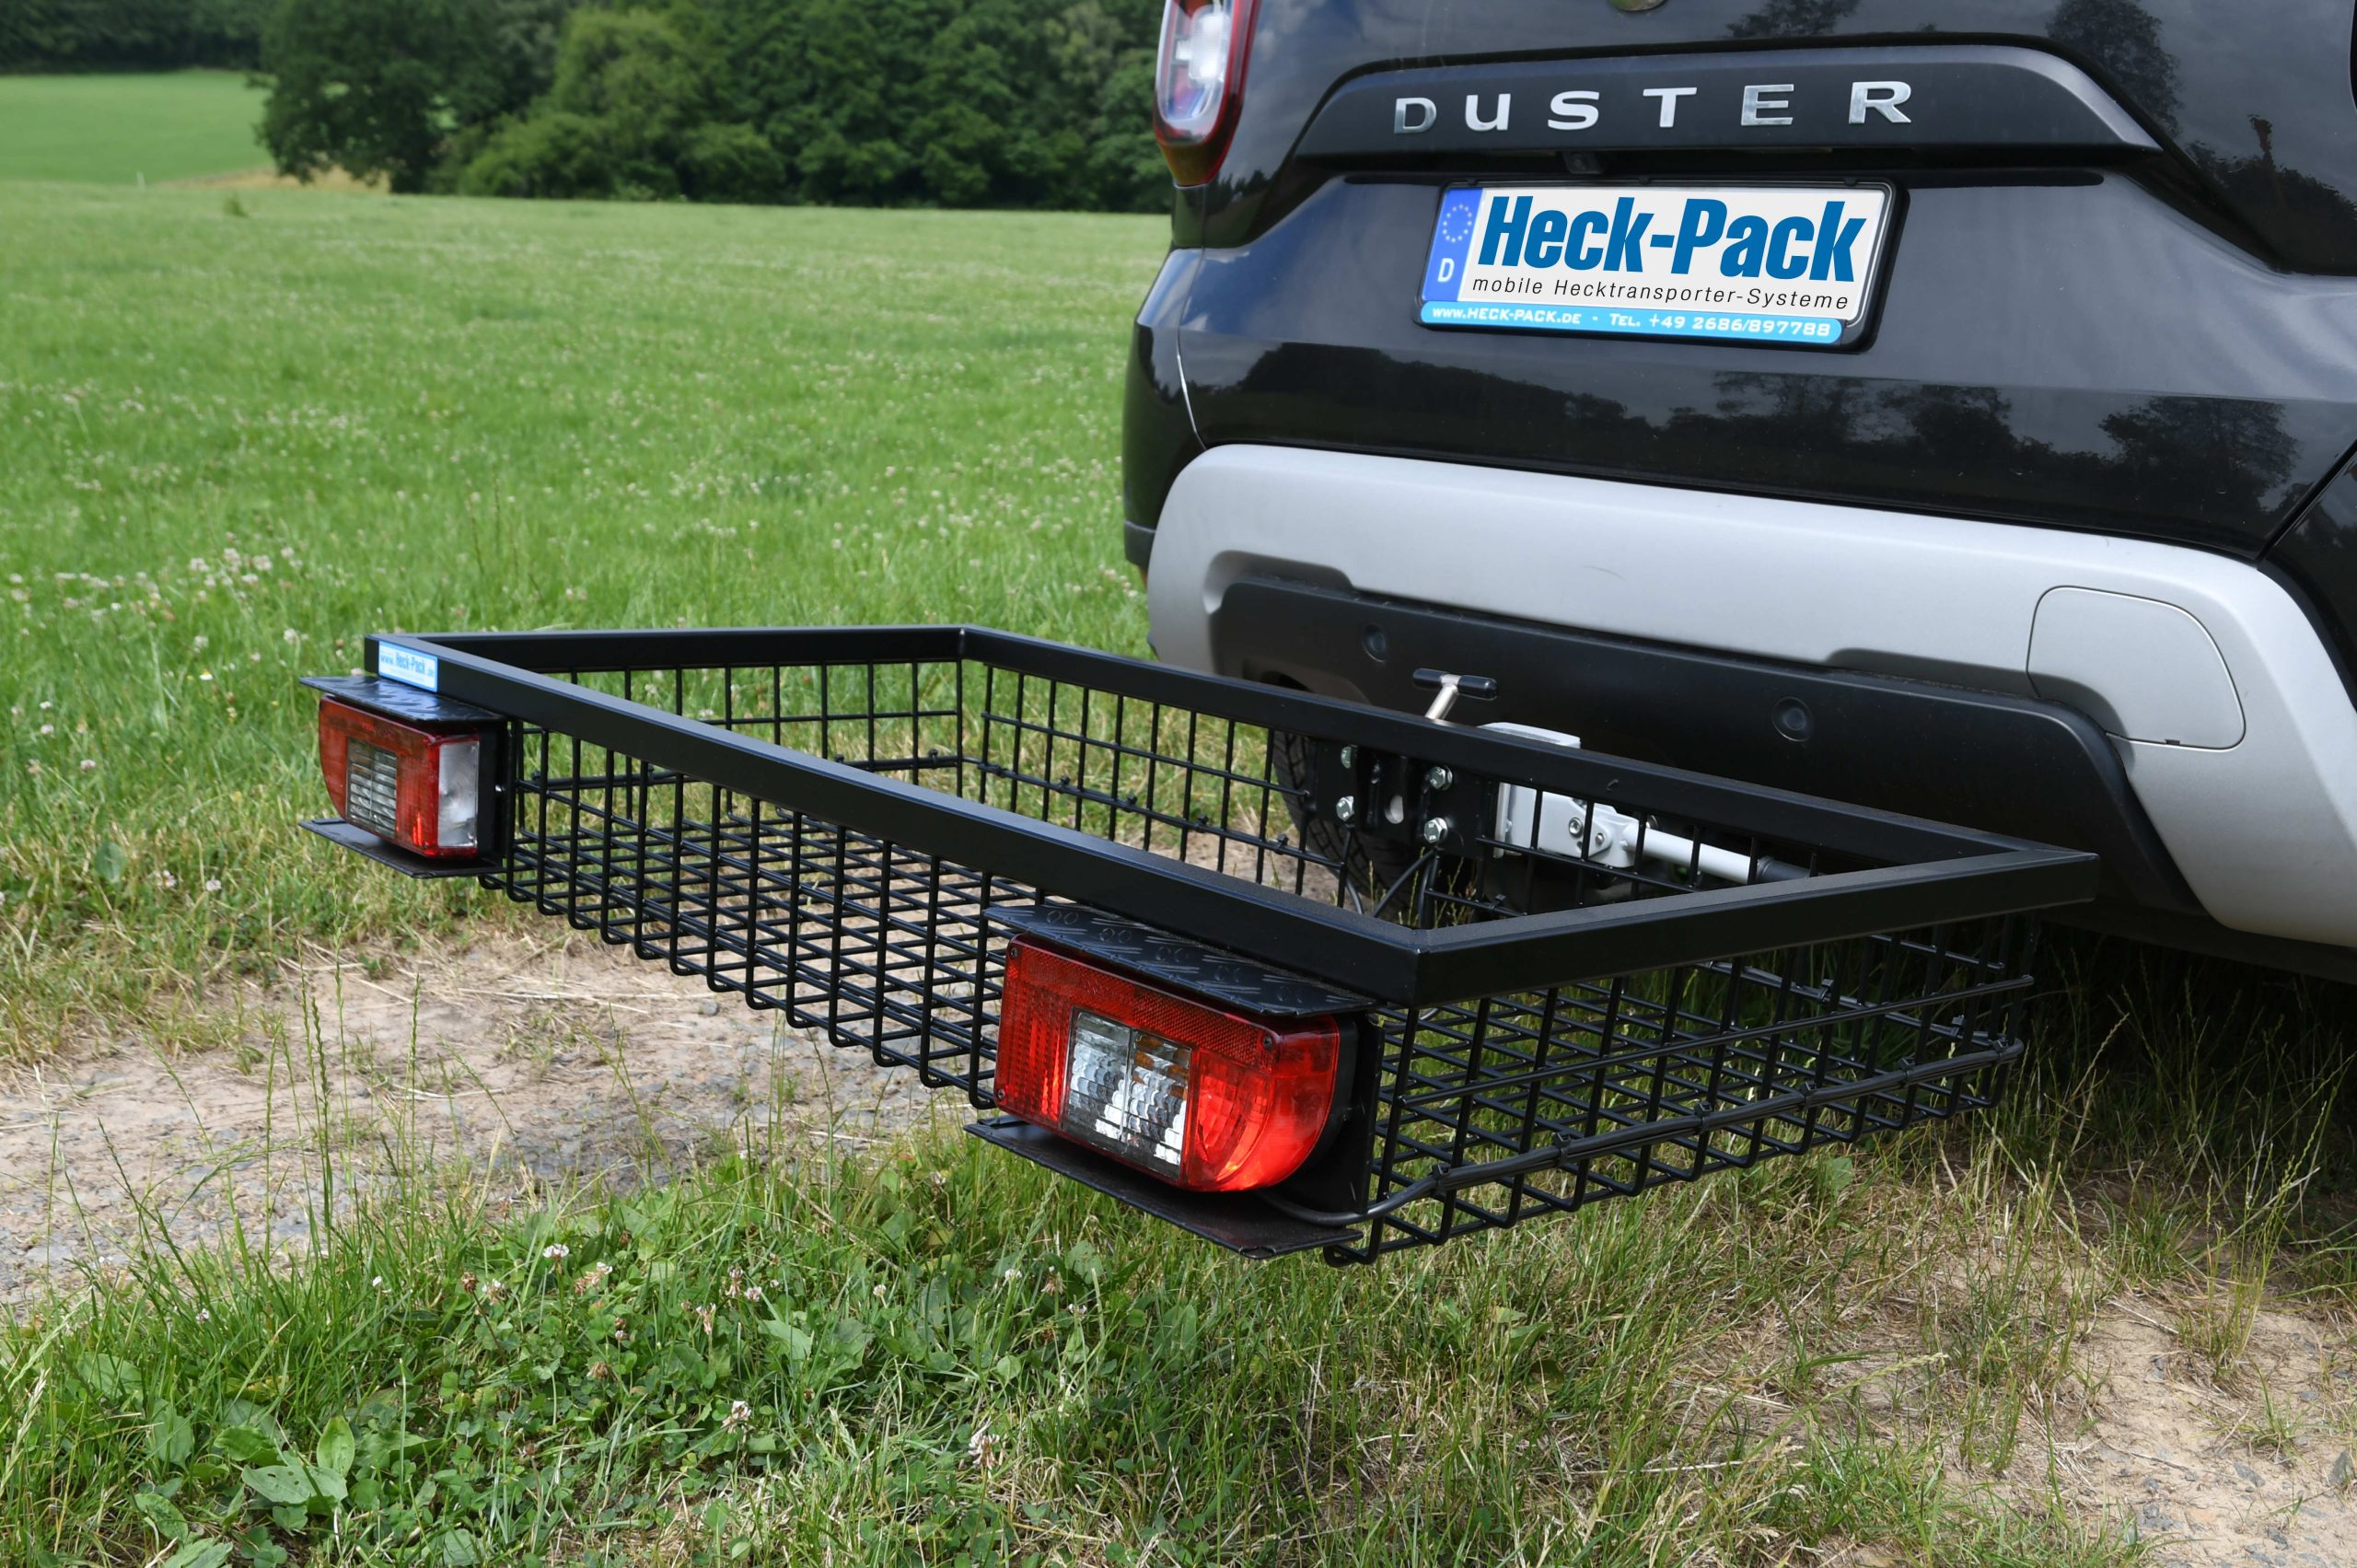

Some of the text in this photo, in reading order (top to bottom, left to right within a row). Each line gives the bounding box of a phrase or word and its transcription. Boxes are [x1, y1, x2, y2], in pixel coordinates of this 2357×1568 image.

[1394, 81, 1911, 134] DUSTER
[1478, 195, 1866, 282] Heck-Pack
[1437, 258, 1454, 283] D
[1472, 277, 1849, 309] mobile Hecktransporter-Systeme
[1650, 314, 1686, 329] +49
[1692, 317, 1831, 337] 2686/897788
